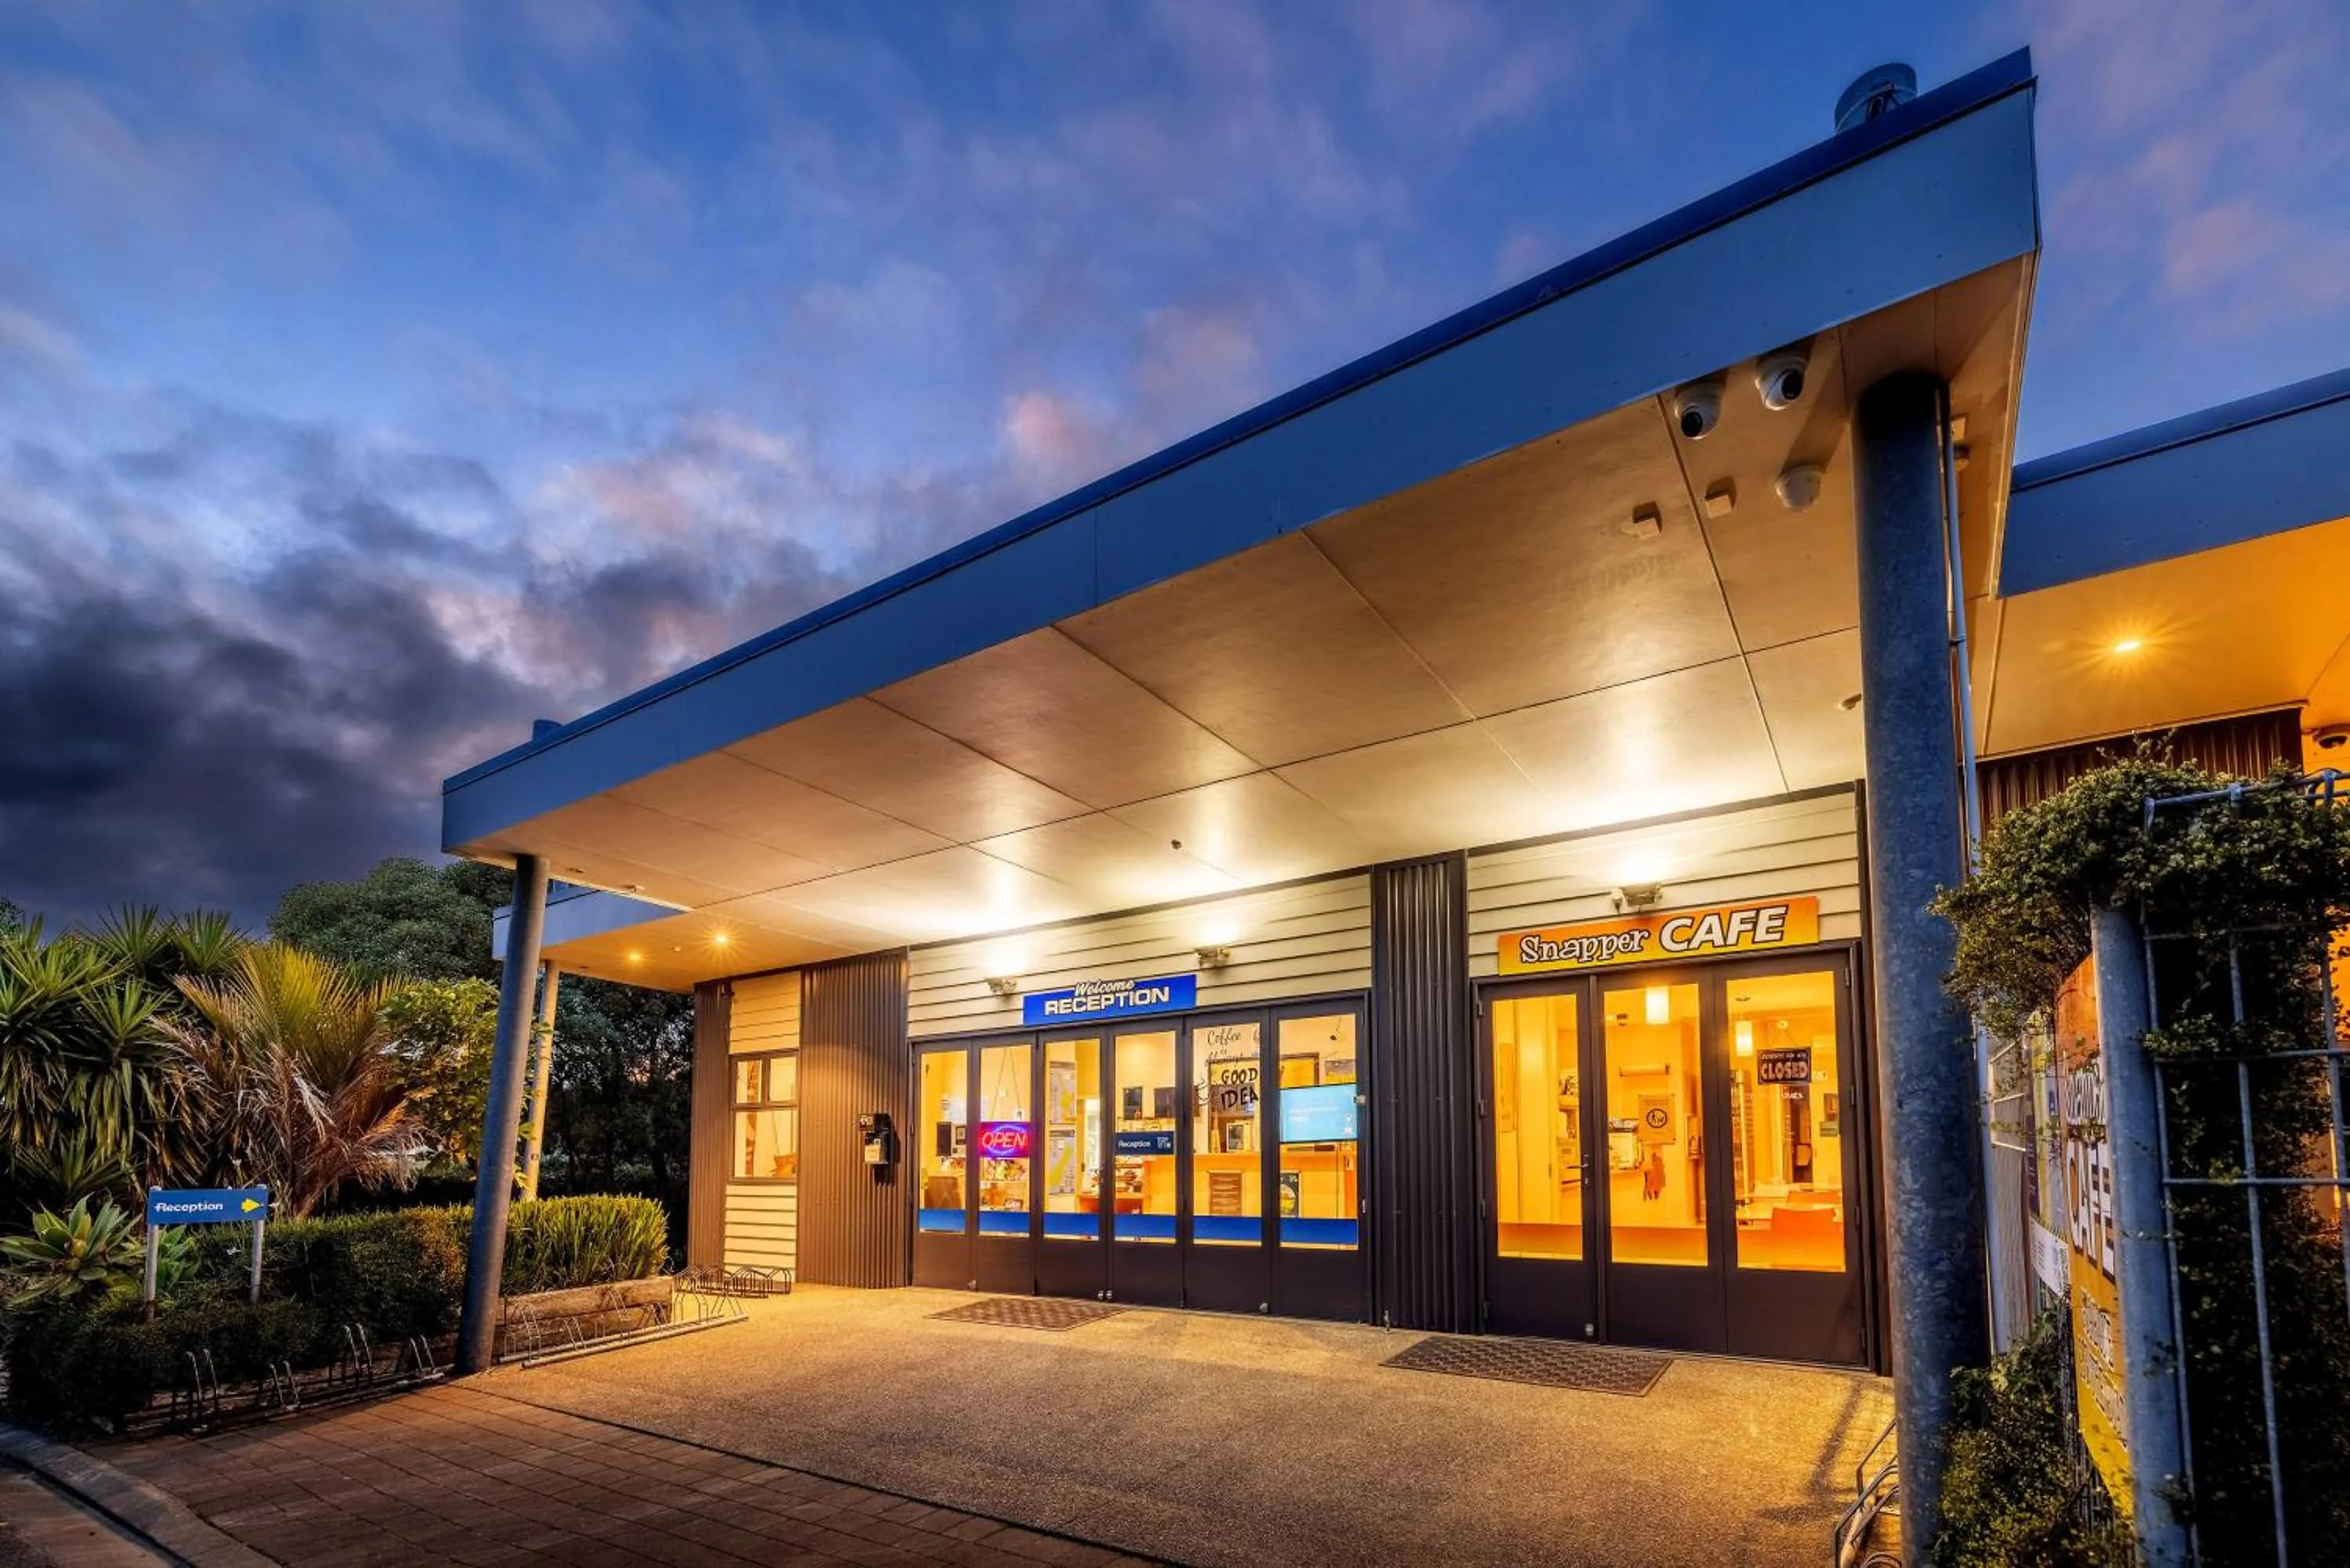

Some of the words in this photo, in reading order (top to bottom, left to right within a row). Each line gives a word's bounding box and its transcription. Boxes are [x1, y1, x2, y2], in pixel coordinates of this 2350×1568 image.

[1520, 929, 1650, 963] Snapper
[1659, 905, 1790, 952] CAFE
[1075, 980, 1136, 996] Welcome
[1044, 987, 1170, 1016] RECEPTION
[1207, 1028, 1242, 1046] Coffee
[1221, 1068, 1258, 1085] GOOD
[1761, 1061, 1808, 1080] CLOSED
[1221, 1086, 1259, 1111] IDEA
[982, 1132, 1028, 1148] OPEN
[1119, 1140, 1151, 1148] Reception
[154, 1201, 223, 1212] Reception
[2067, 1137, 2116, 1281] CAFE
